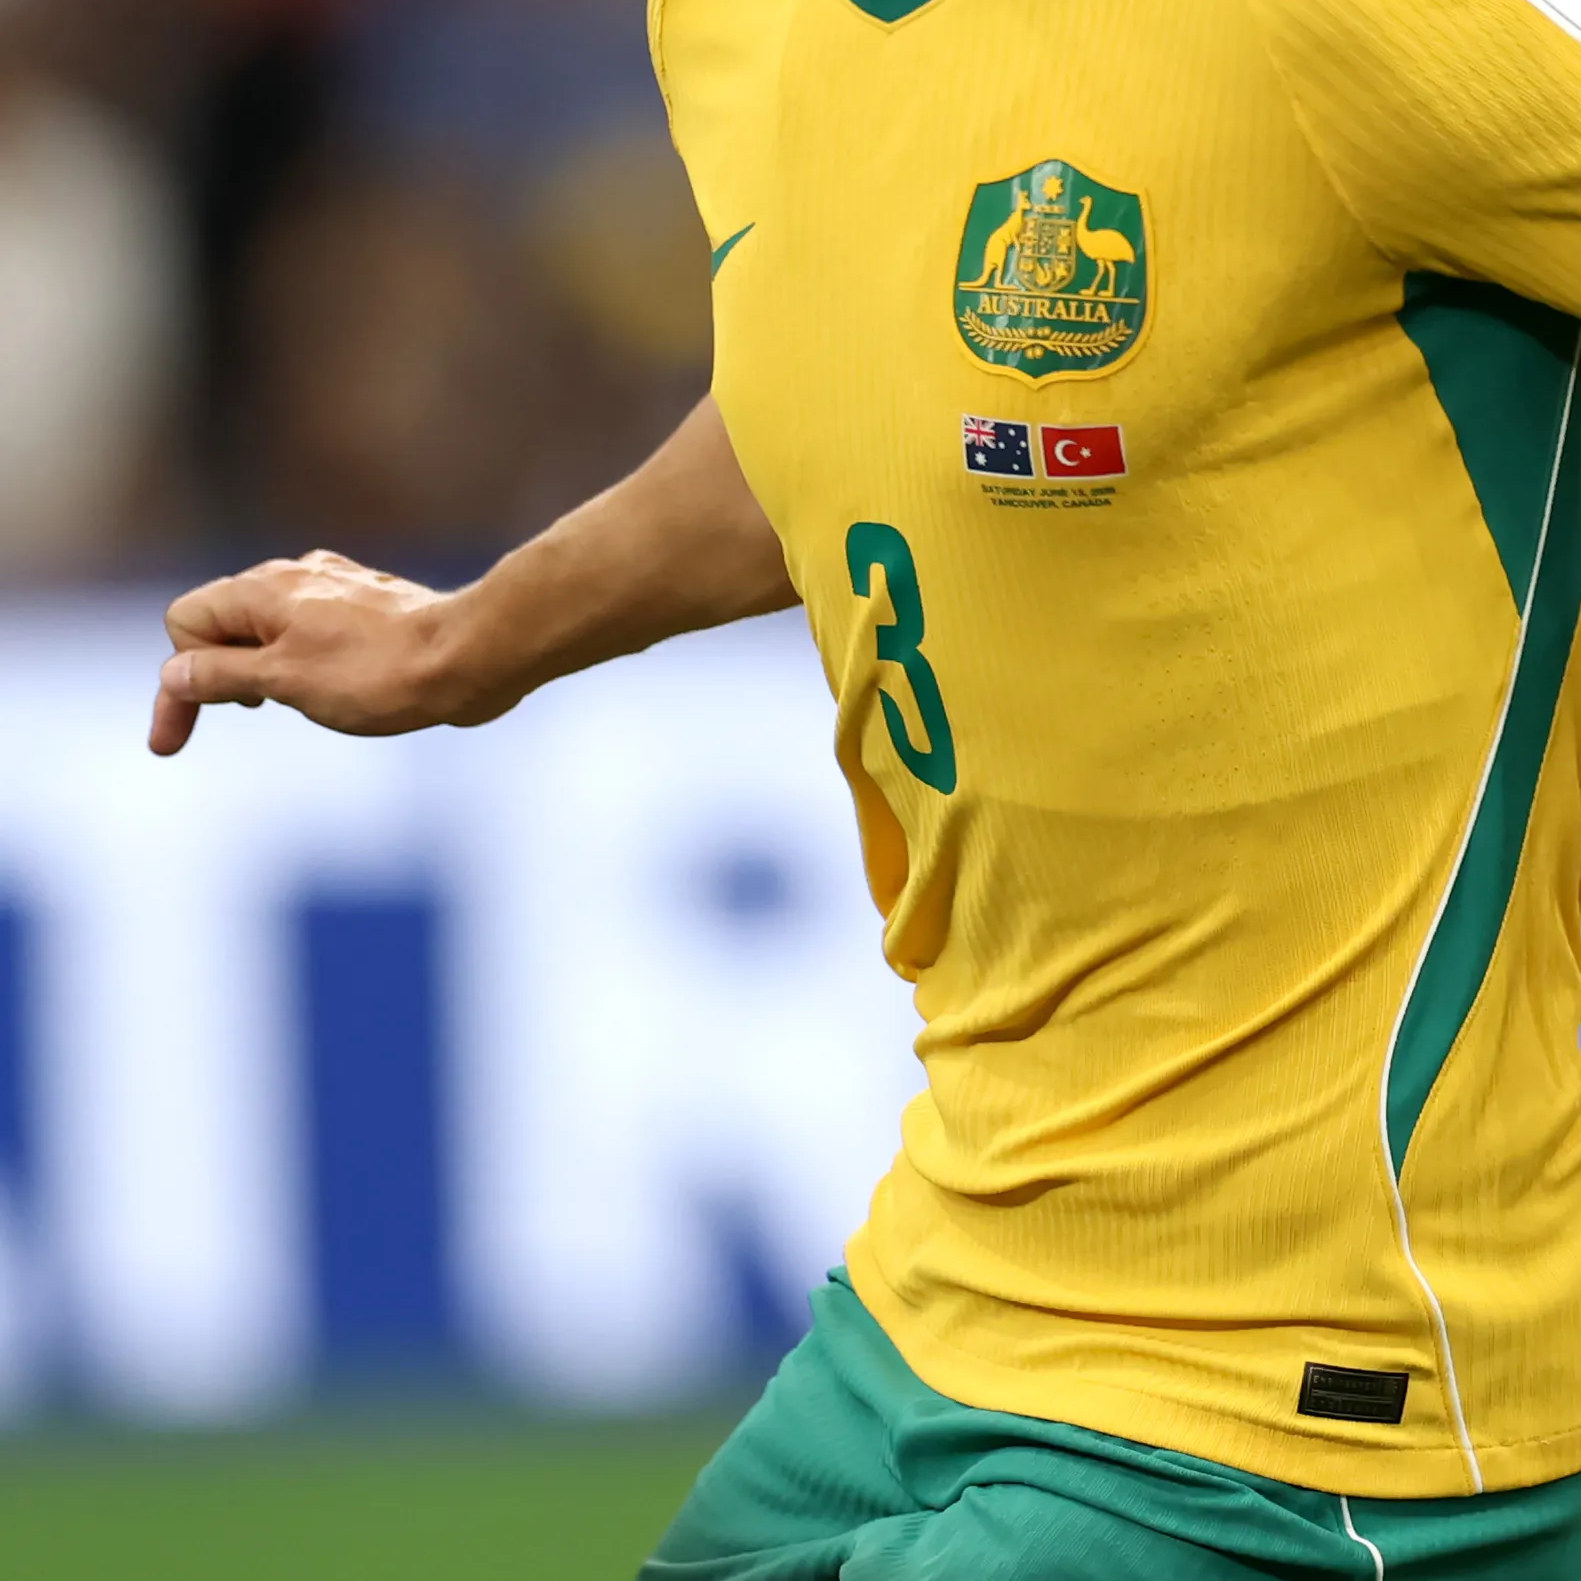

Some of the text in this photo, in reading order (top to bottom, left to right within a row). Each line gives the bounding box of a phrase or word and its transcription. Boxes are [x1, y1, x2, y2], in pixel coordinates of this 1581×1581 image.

[977, 293, 1112, 324] AUSTRALIA
[981, 483, 1036, 497] SATURDAY
[1061, 498, 1113, 509] CANADA
[845, 521, 958, 797] 3
